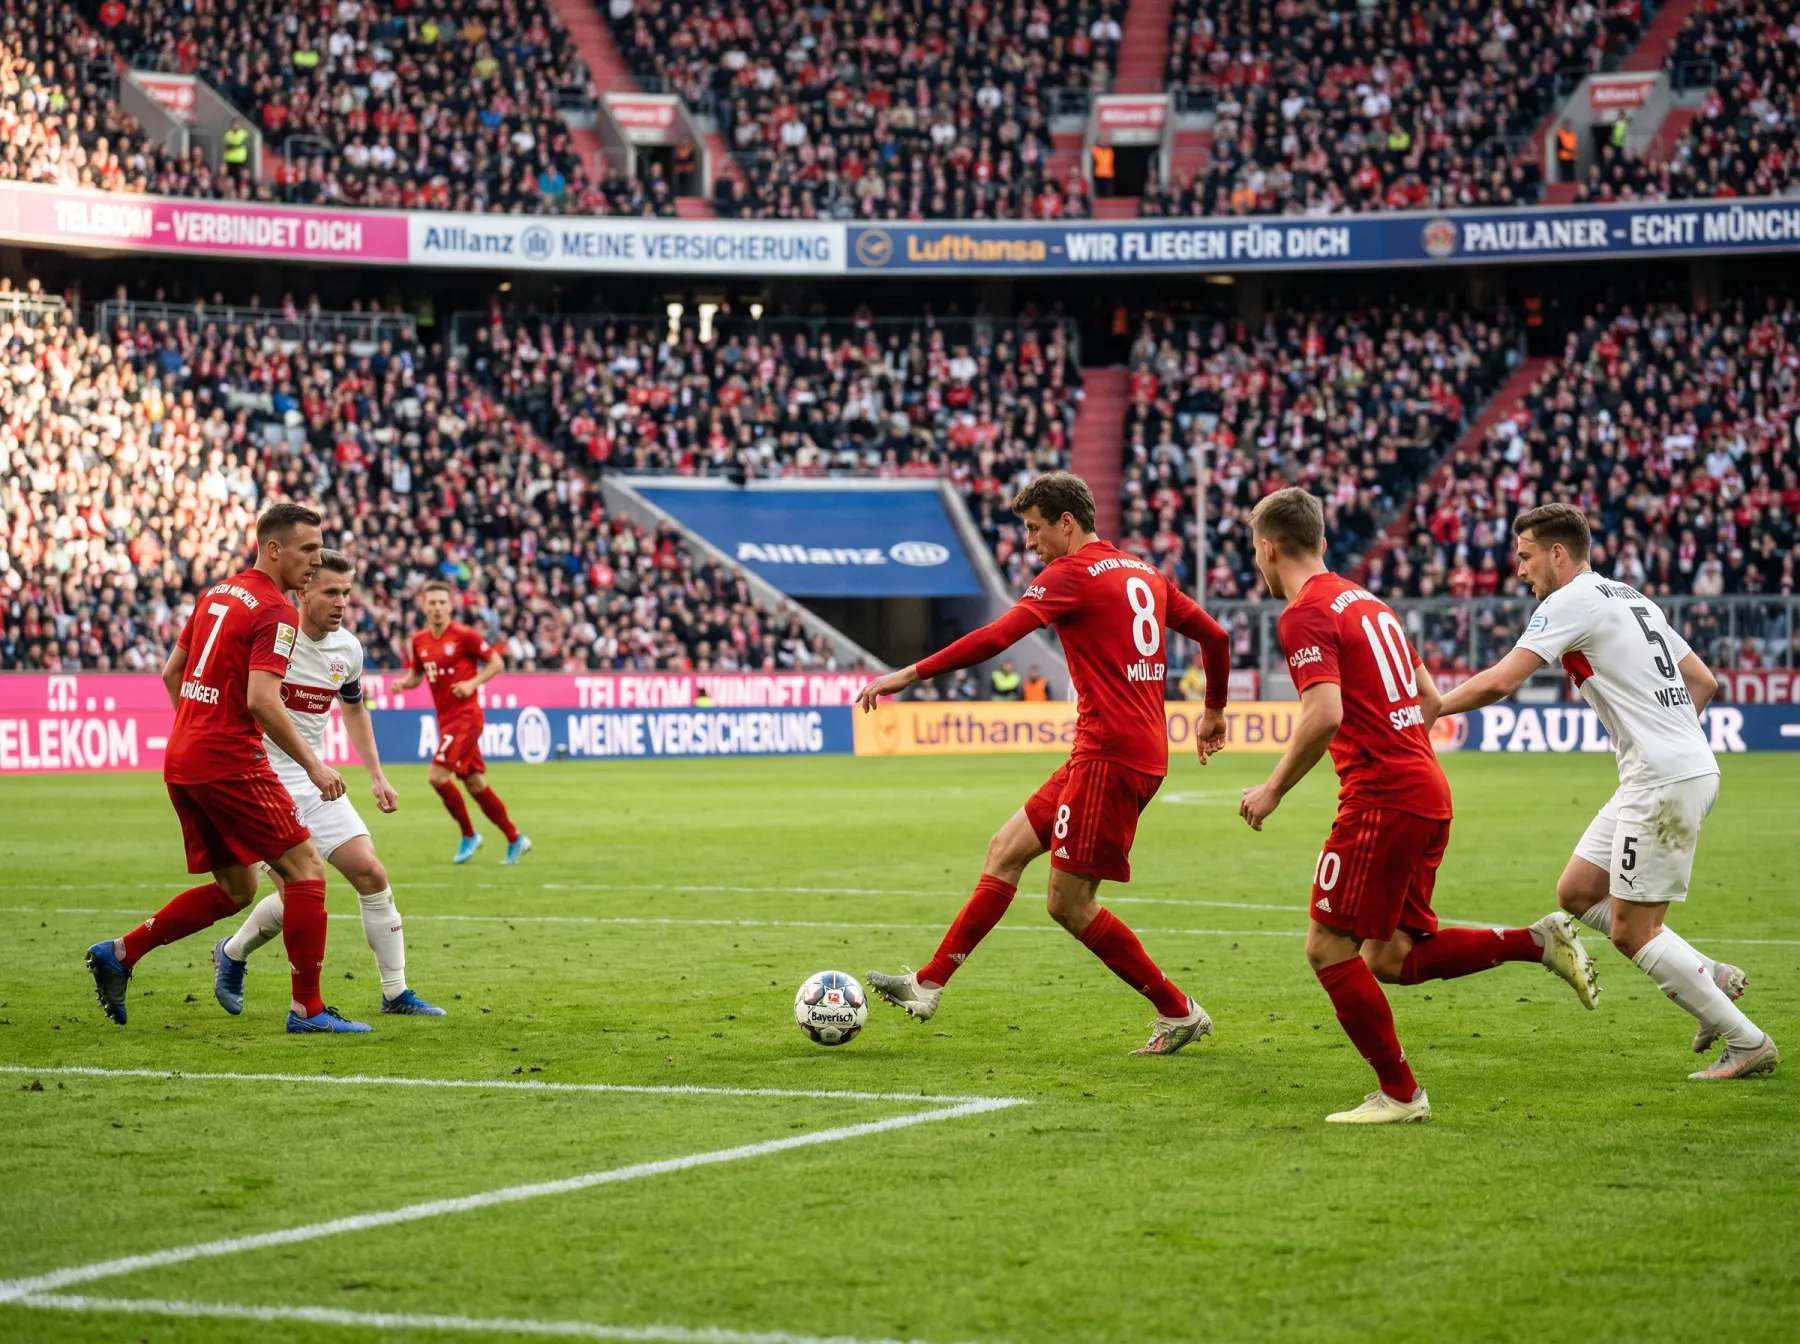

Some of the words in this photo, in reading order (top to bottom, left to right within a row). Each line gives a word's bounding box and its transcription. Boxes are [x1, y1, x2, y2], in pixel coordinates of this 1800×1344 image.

[54, 201, 153, 239] TELEKOM
[172, 209, 301, 248] VERBINDET
[304, 219, 362, 252] DICH
[423, 227, 513, 255] Allianz
[907, 234, 1046, 262] Lufthansa
[1066, 233, 1117, 261] WIR
[1122, 230, 1227, 260] FLIEGEN
[1231, 223, 1284, 258] FÜR
[1287, 227, 1350, 257] DICH
[1463, 219, 1609, 251] PAULANER
[1631, 214, 1699, 245] ECHT
[1704, 206, 1800, 242] MÜNCH
[561, 232, 635, 260] MEINE
[643, 233, 831, 262] VERSICHERUNG
[737, 542, 887, 565] Allianz
[1126, 577, 1160, 657] 8
[193, 602, 229, 678] 7
[1361, 611, 1418, 703] 10
[1630, 606, 1676, 681] 5
[180, 679, 219, 705] KRÜGER
[0, 717, 138, 769] ELEKOM
[440, 733, 454, 753] 7
[567, 714, 646, 756] MEINE
[647, 711, 824, 755] VERSICHERUNG
[912, 712, 1076, 745] Lufthansa
[1055, 804, 1071, 839] 8
[1622, 836, 1638, 871] 5
[811, 1011, 853, 1025] Bayerisch
